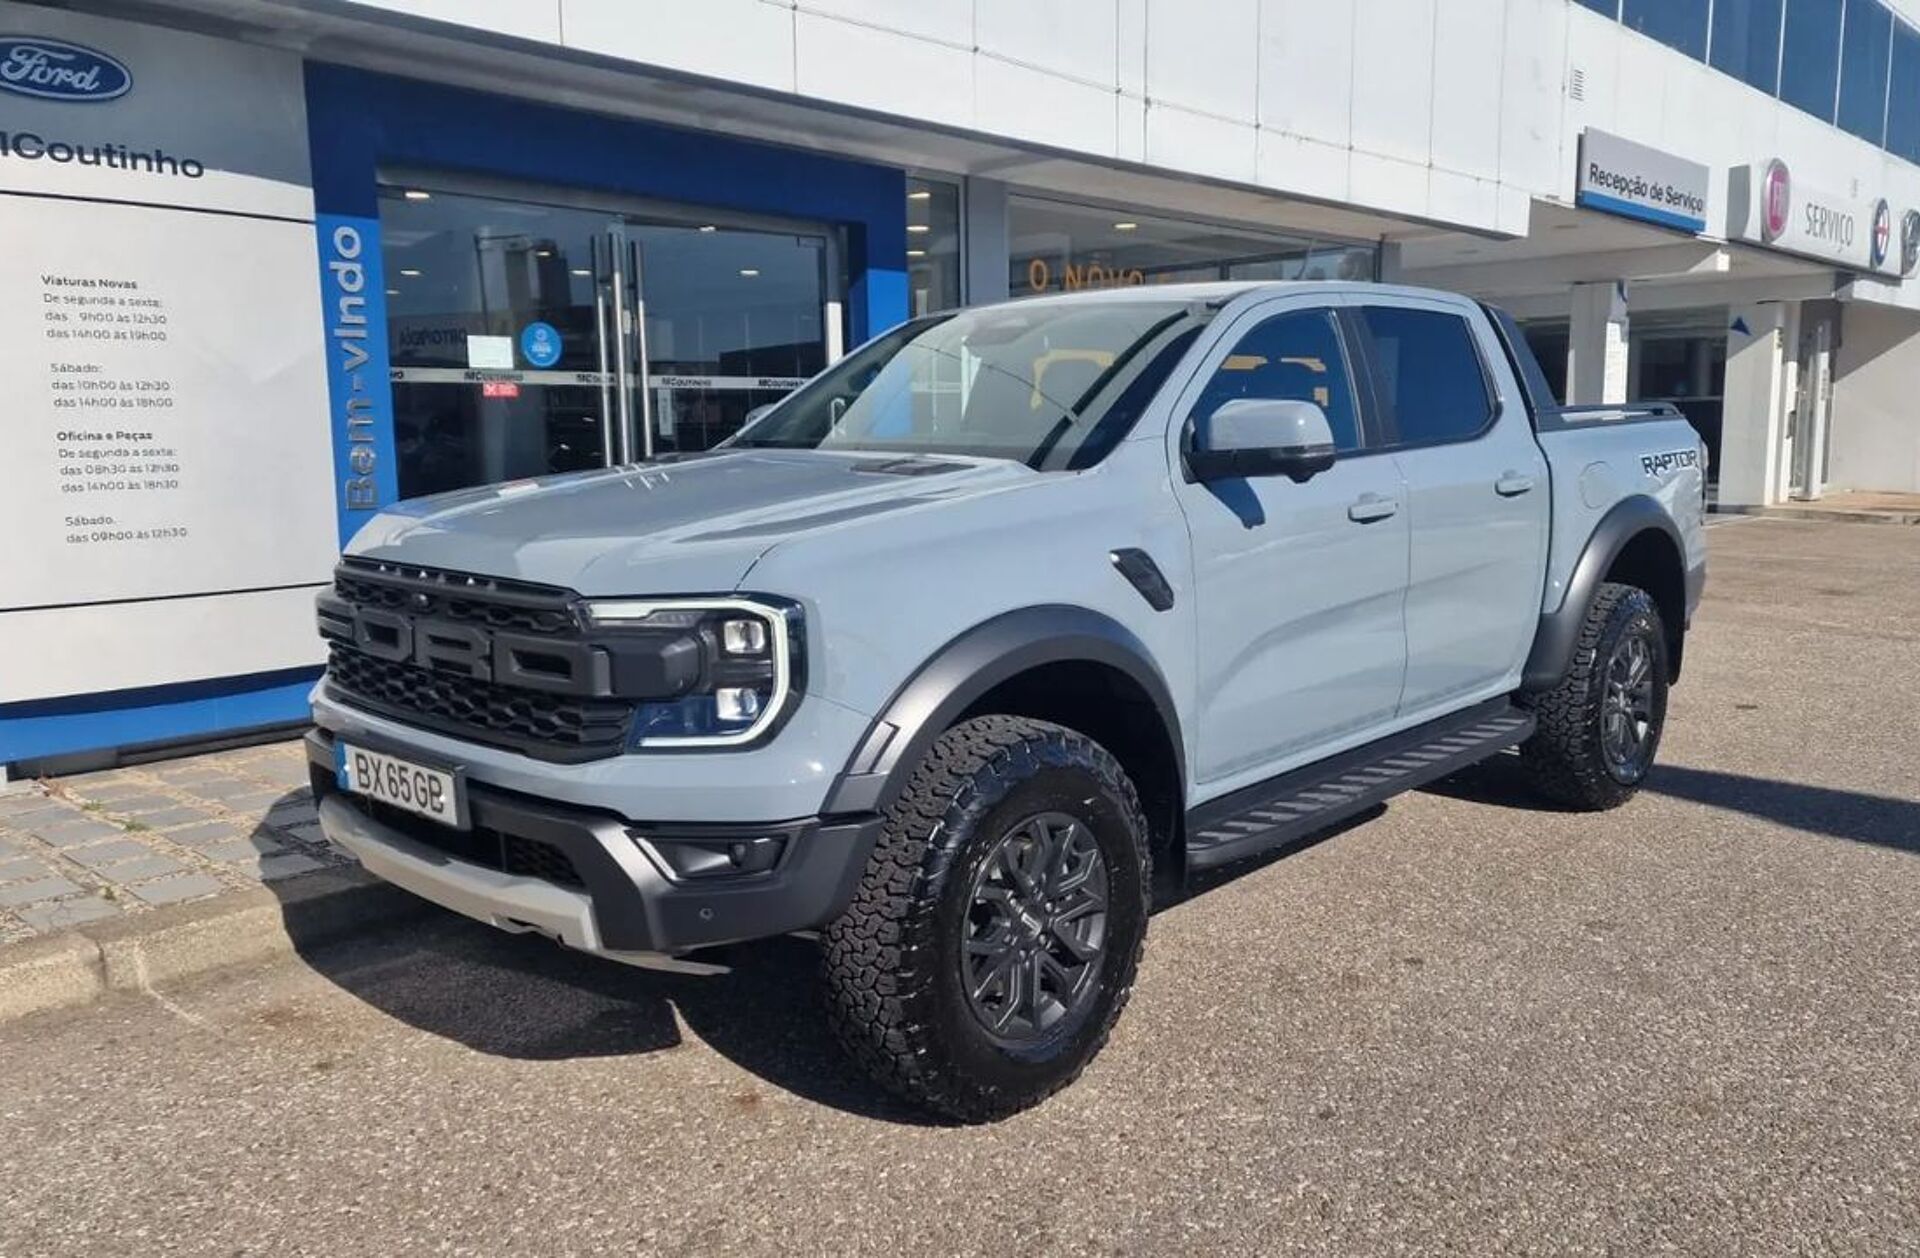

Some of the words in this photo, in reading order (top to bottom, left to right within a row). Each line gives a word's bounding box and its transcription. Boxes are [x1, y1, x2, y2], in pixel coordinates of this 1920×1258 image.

[1, 45, 100, 92] Ford
[0, 131, 204, 179] Coutinho
[1590, 162, 1648, 198] Recepção
[1650, 183, 1663, 202] de
[1665, 186, 1703, 215] Serviço
[1805, 203, 1854, 253] SERVIÇO
[41, 275, 96, 287] Viaturas
[99, 279, 138, 289] Novas
[1029, 259, 1048, 292] O
[43, 293, 60, 303] De
[63, 295, 116, 307] segunda
[45, 312, 68, 322] das
[79, 312, 114, 322] 9h00
[133, 313, 168, 324] 12h30
[46, 329, 70, 338] das
[72, 329, 111, 339] 14h00
[130, 330, 167, 341] 19h00
[51, 380, 75, 390] das
[77, 380, 116, 390] 10h00
[136, 381, 171, 391] 12h30
[53, 398, 77, 408] das
[79, 398, 117, 408] 14h00
[56, 431, 103, 441] Oficina
[105, 433, 113, 441] e
[116, 431, 153, 442] Peças
[58, 449, 75, 458] De
[79, 449, 130, 460] segunda
[60, 465, 82, 475] das
[85, 464, 127, 475] 08h30
[145, 463, 180, 473] 12h30
[1641, 450, 1698, 477] RAPTOR
[61, 482, 85, 493] das
[87, 481, 125, 491] 14h00
[66, 533, 89, 543] das
[91, 531, 133, 542] 09h00
[152, 527, 188, 538] 12h30
